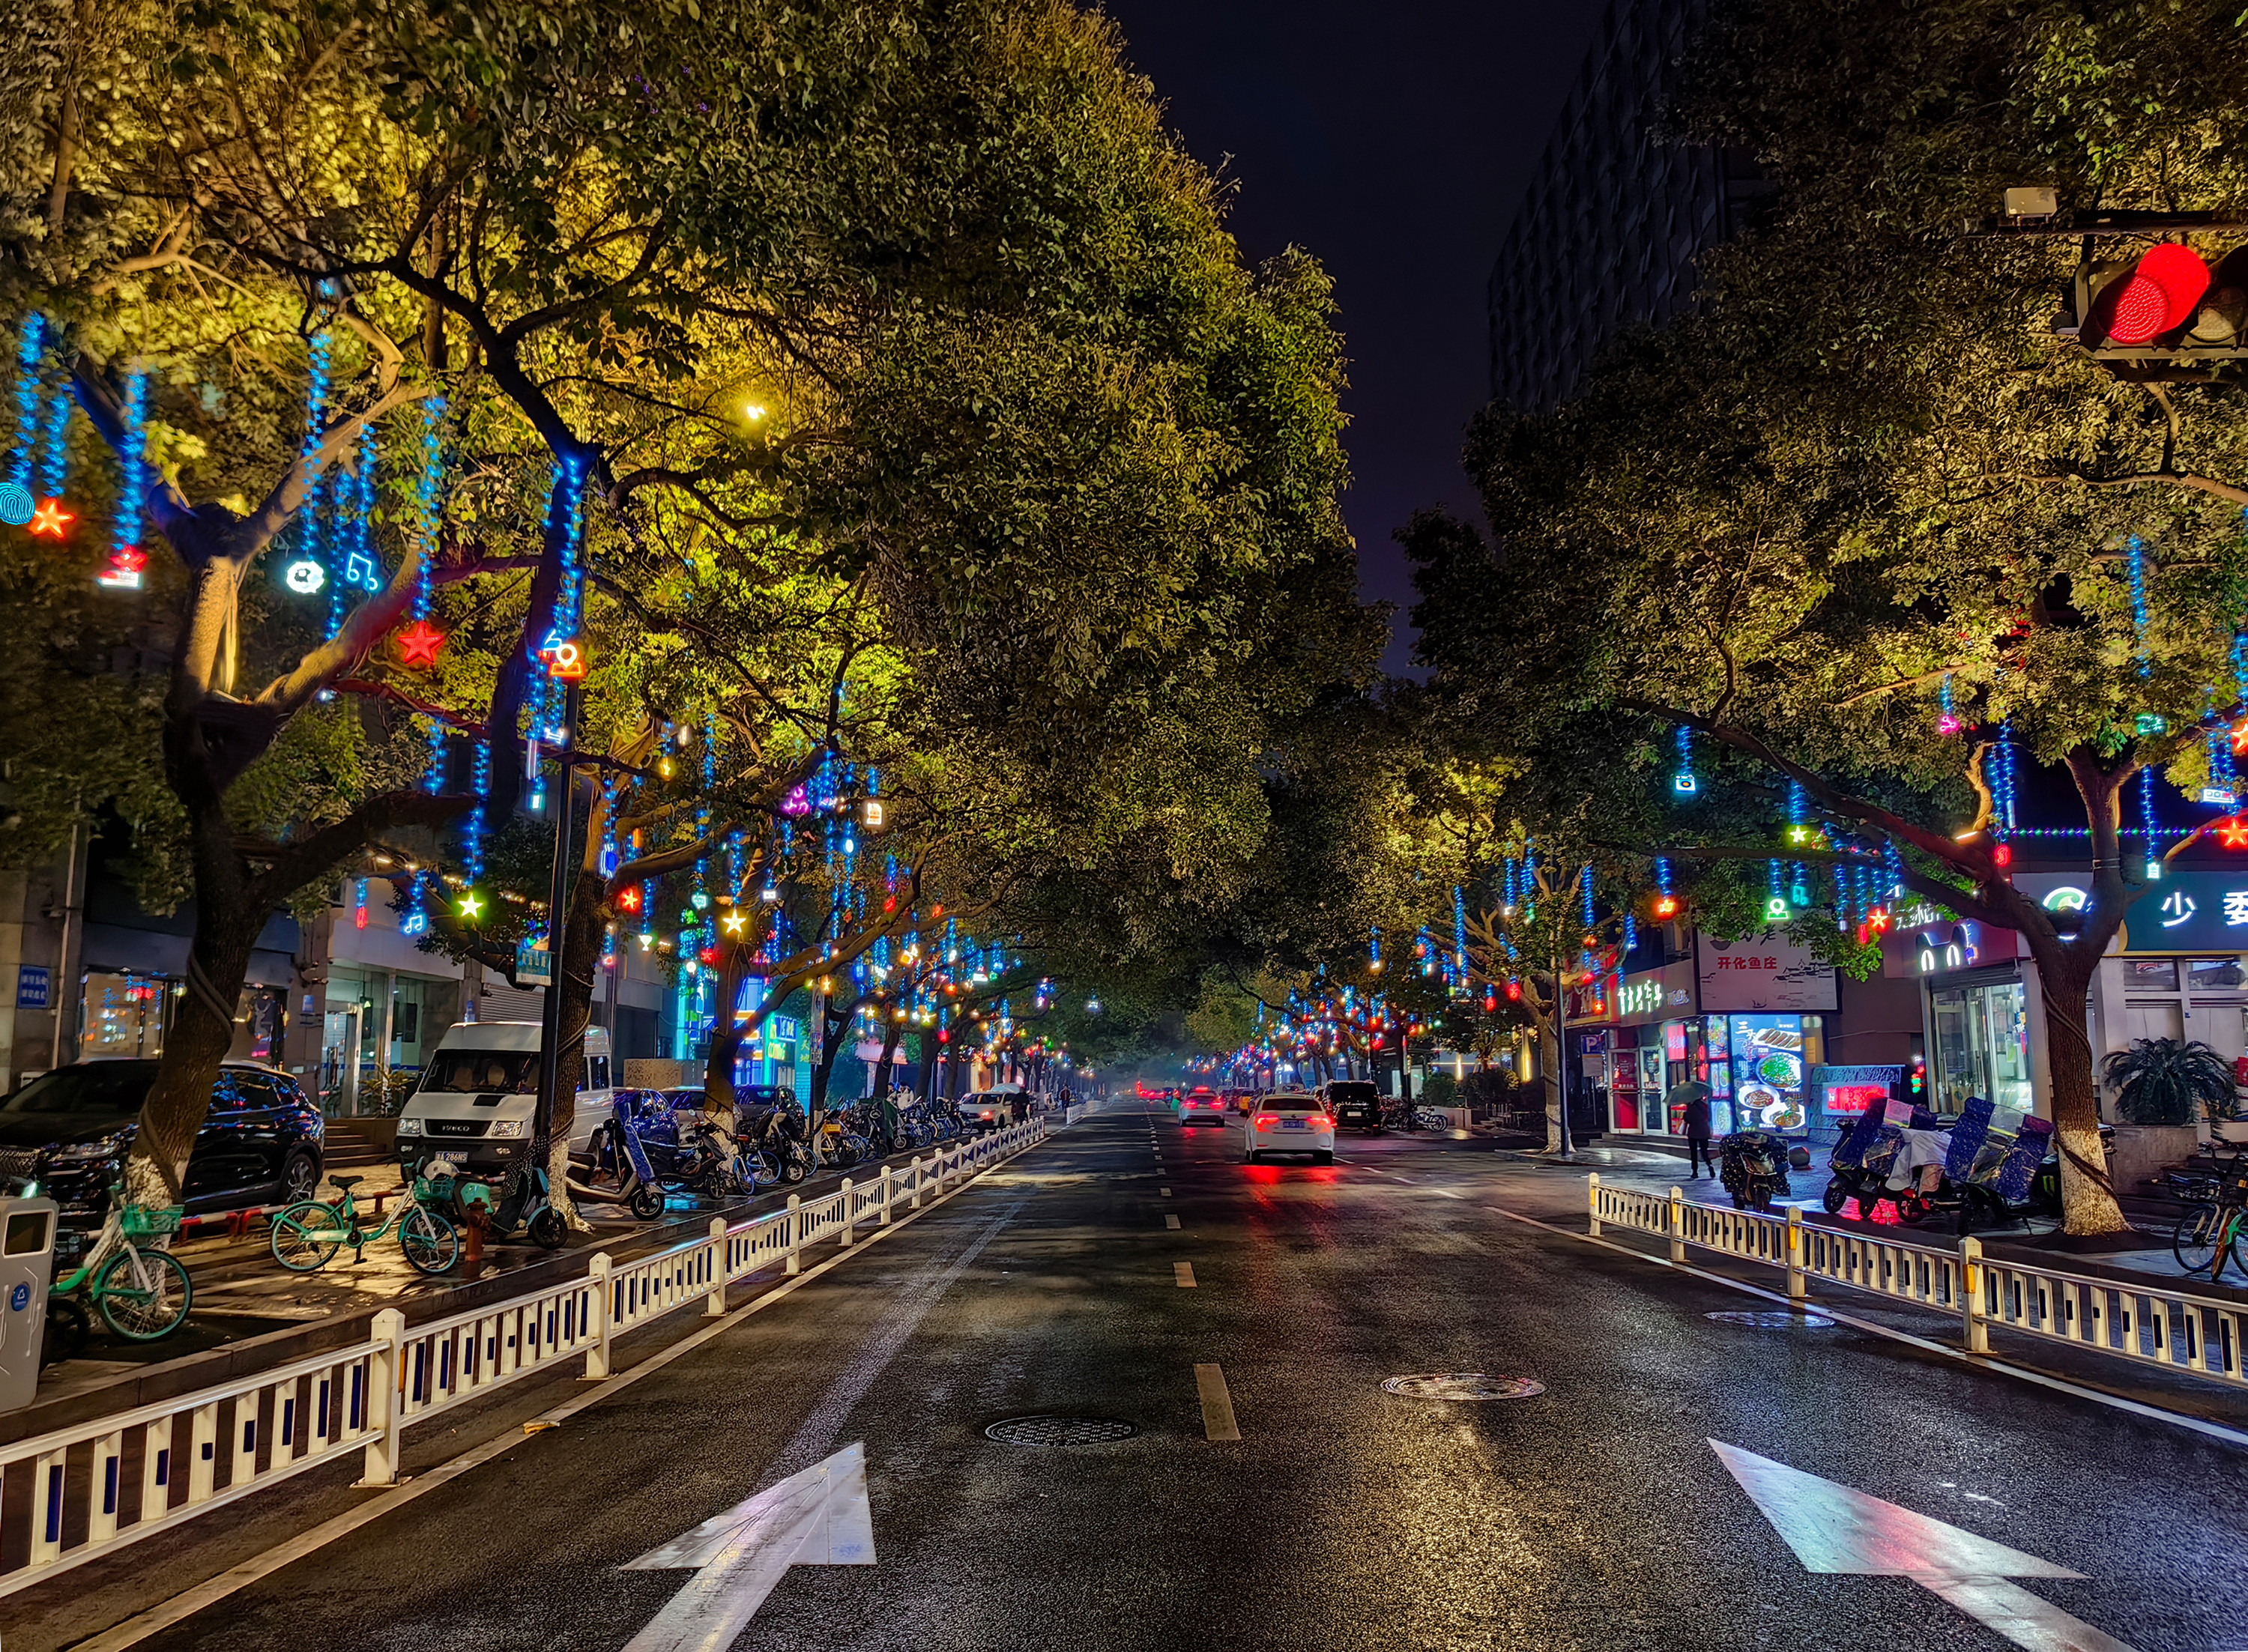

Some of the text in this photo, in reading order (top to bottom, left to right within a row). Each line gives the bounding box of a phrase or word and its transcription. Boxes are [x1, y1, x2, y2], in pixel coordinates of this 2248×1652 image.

[1717, 956, 1777, 969] 开化鱼庄
[1586, 1037, 1597, 1053] P
